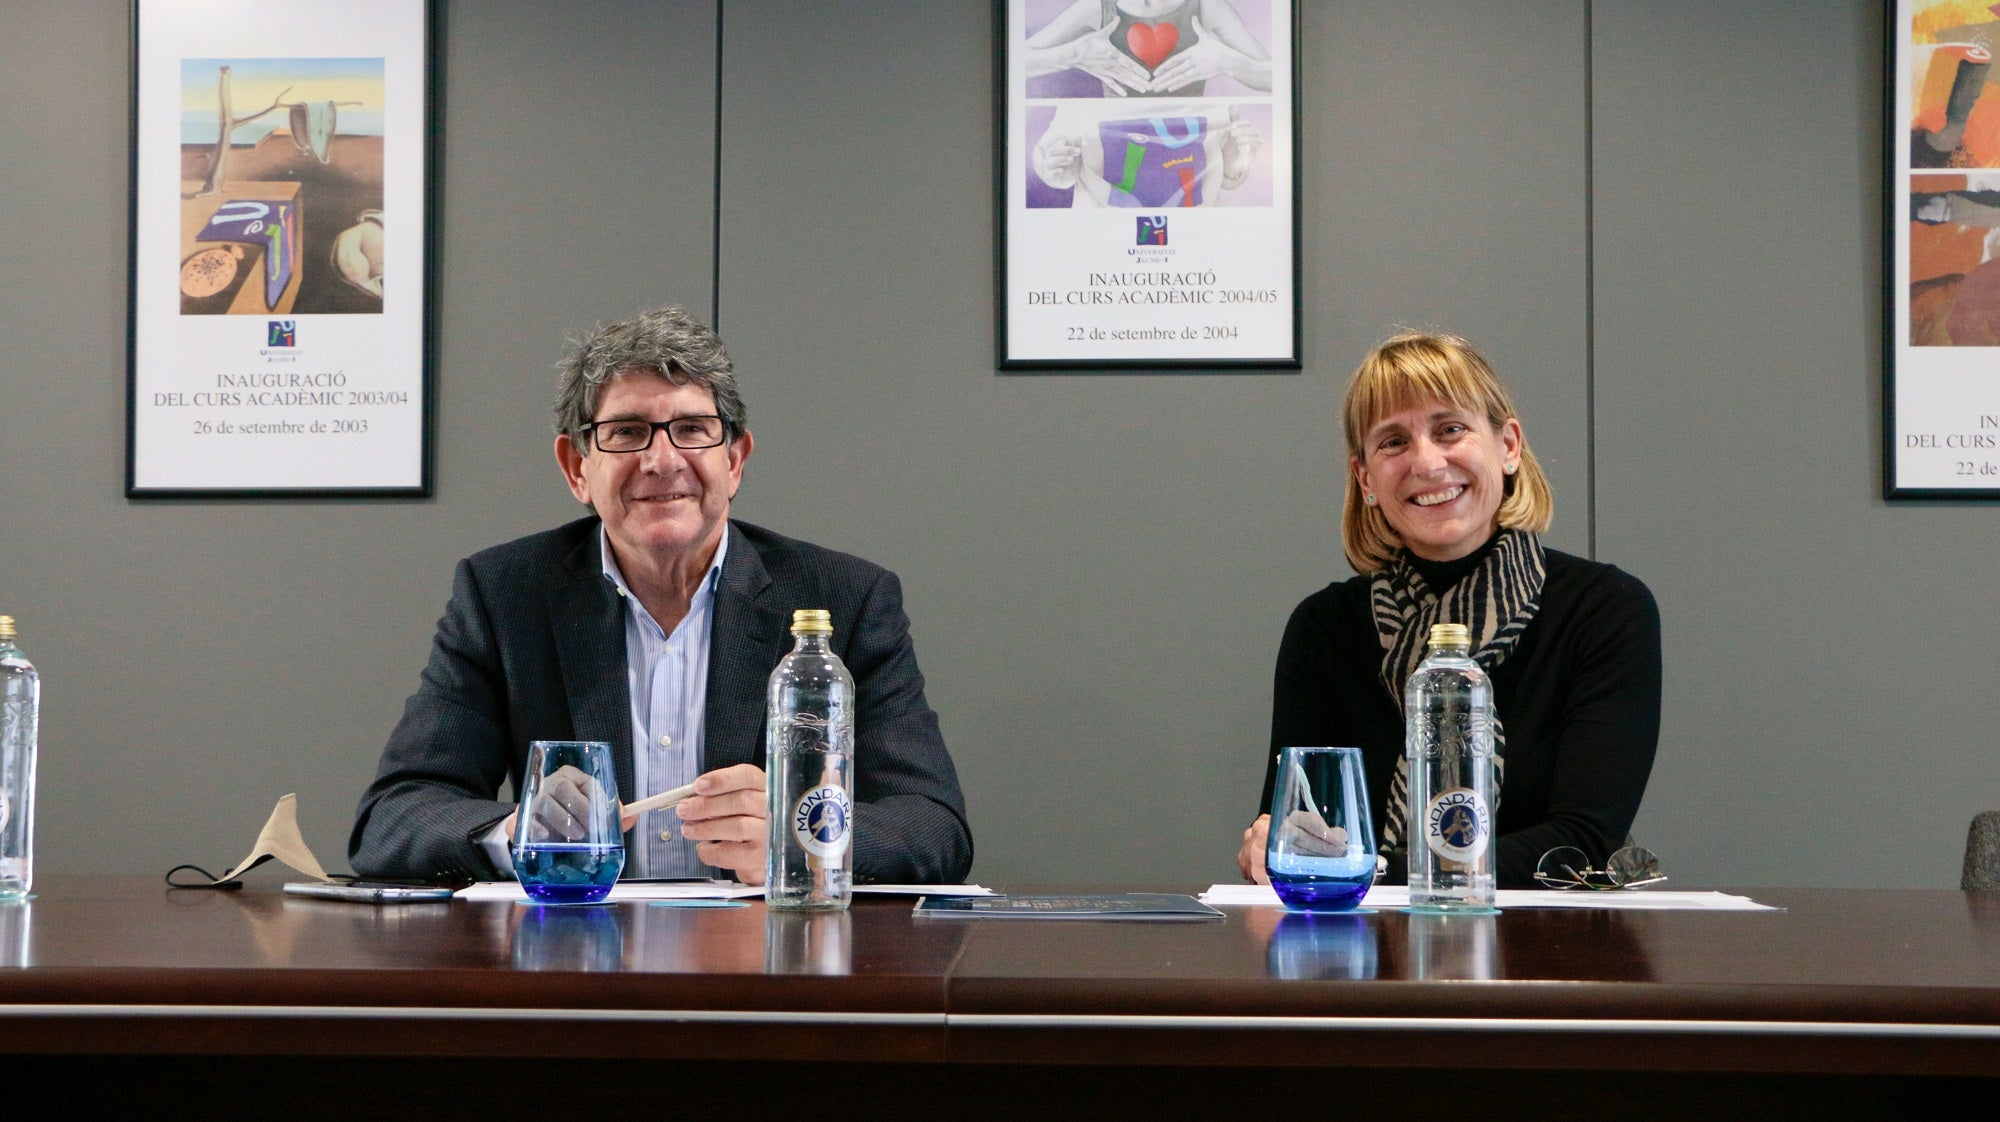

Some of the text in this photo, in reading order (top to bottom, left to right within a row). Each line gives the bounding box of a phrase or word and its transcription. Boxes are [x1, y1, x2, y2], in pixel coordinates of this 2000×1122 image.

[1089, 268, 1217, 287] INAUGURACIÓ
[1027, 286, 1277, 305] DEL CURS ACADÈMIC 2004/05
[1067, 325, 1239, 341] 22 de setembre de 2004
[217, 369, 347, 388] INAUGURACIÓ
[153, 388, 409, 407] DEL CURS ACADÈMIC 2003/04
[193, 419, 369, 434] 26 de setembre de 2003
[1906, 433, 1996, 448] DEL CURS
[1956, 461, 1998, 475] 22 de
[1430, 793, 1488, 837] MONDARIZ
